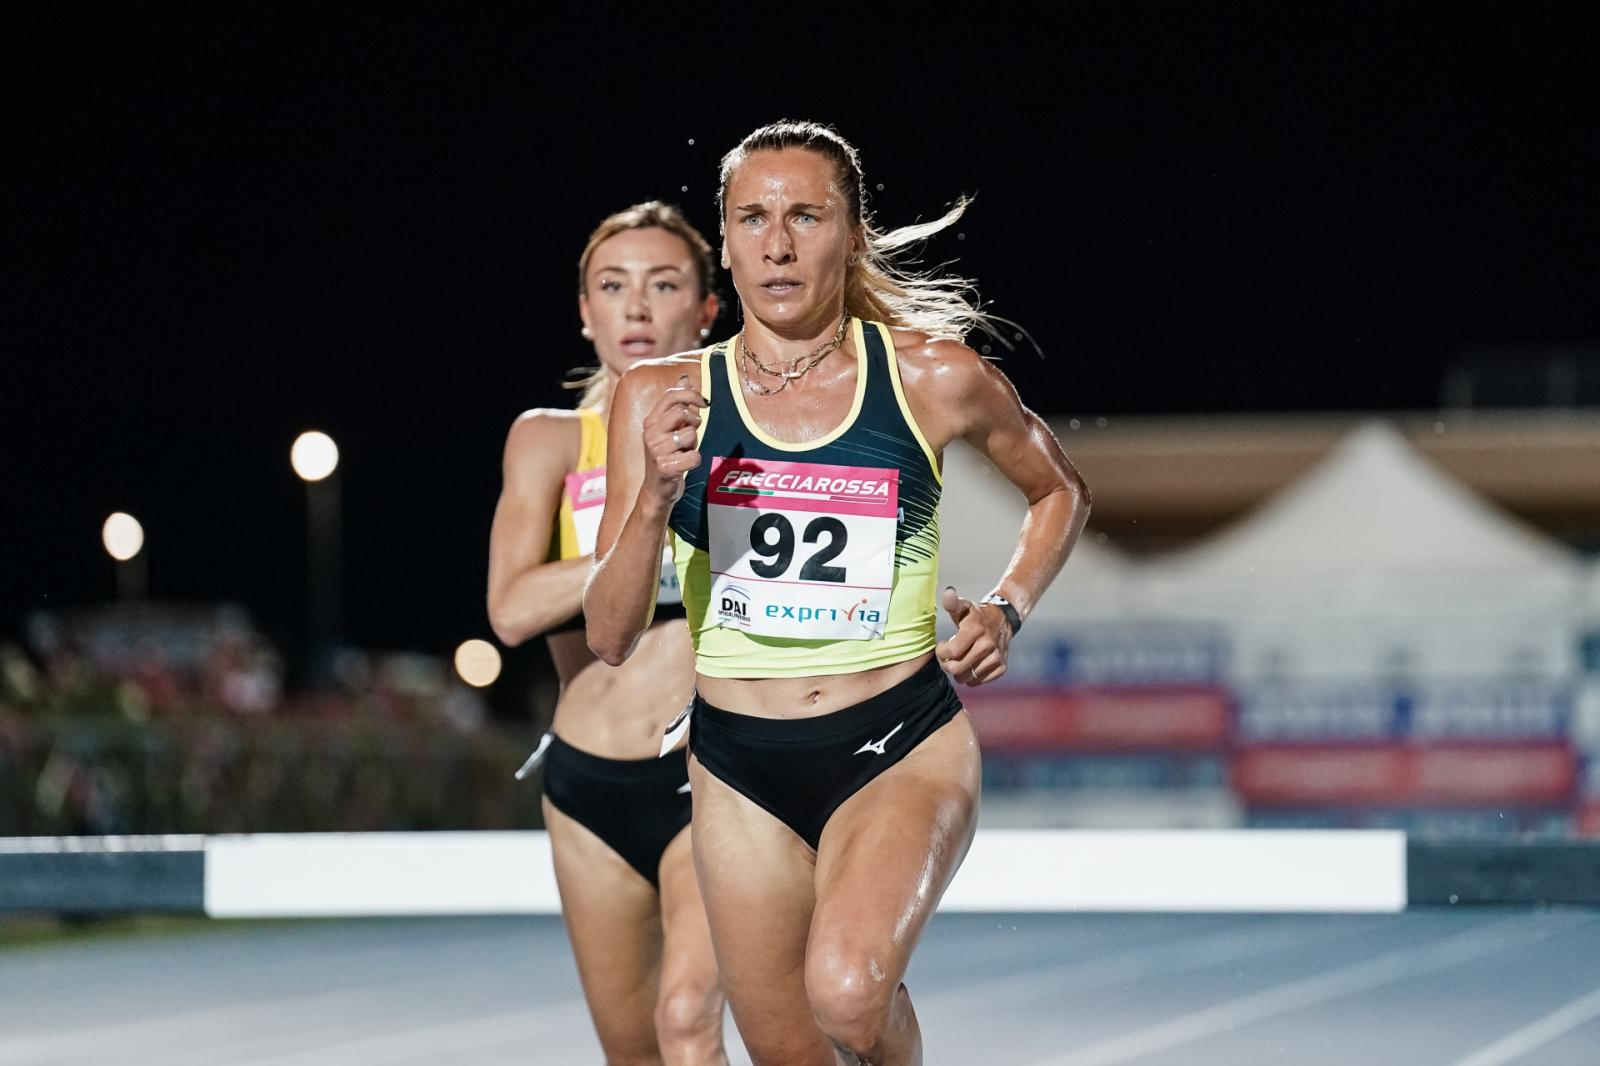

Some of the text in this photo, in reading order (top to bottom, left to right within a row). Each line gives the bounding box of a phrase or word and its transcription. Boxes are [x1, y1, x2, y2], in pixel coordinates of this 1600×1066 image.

[722, 470, 889, 496] FRECCIAROSSA
[749, 512, 848, 583] 92
[722, 597, 747, 616] DAI
[765, 598, 881, 624] exprivia
